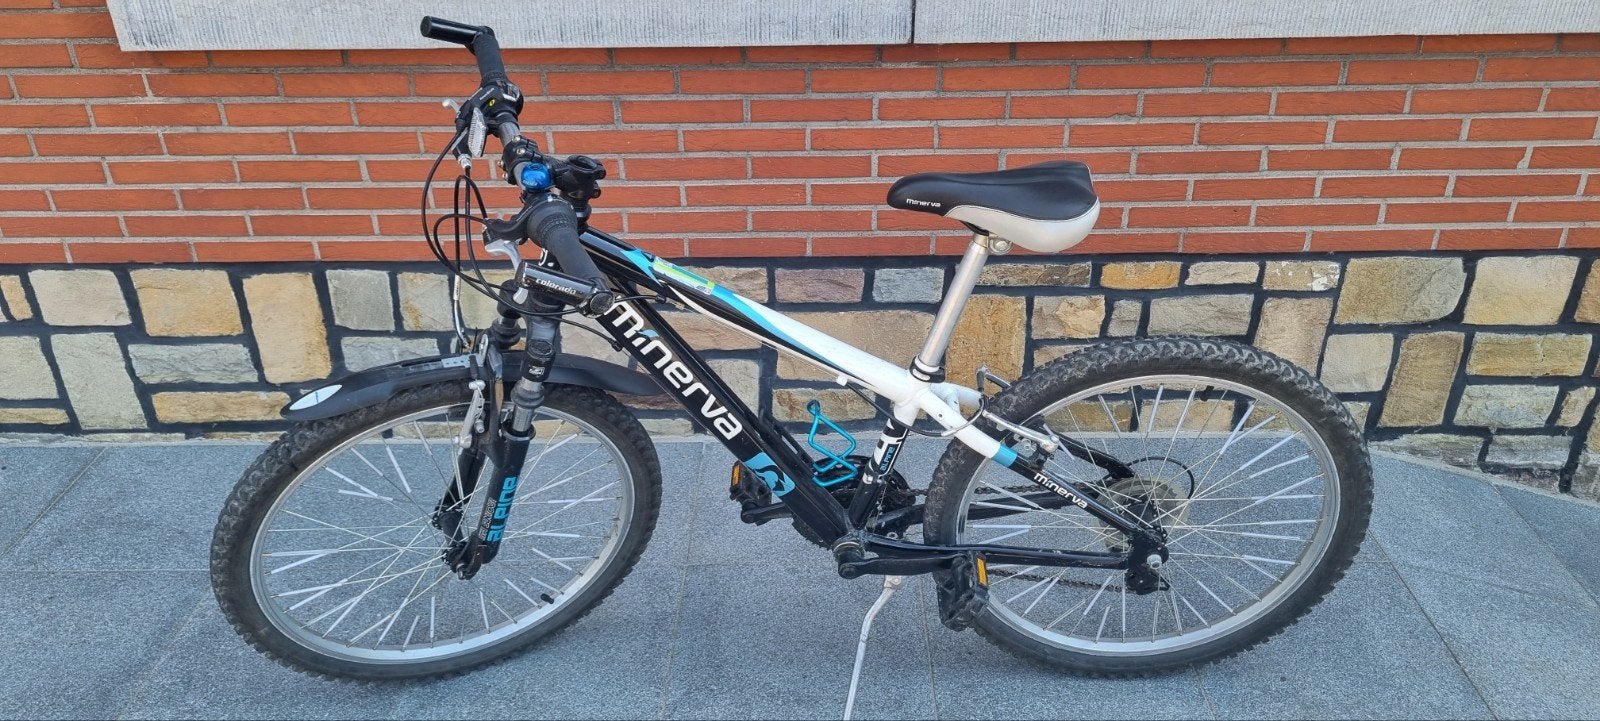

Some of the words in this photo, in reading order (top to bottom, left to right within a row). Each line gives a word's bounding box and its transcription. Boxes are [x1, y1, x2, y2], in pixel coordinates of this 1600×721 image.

[906, 198, 941, 208] minerva
[535, 278, 577, 295] colorado
[603, 295, 743, 441] minerva
[1033, 473, 1088, 509] minerva
